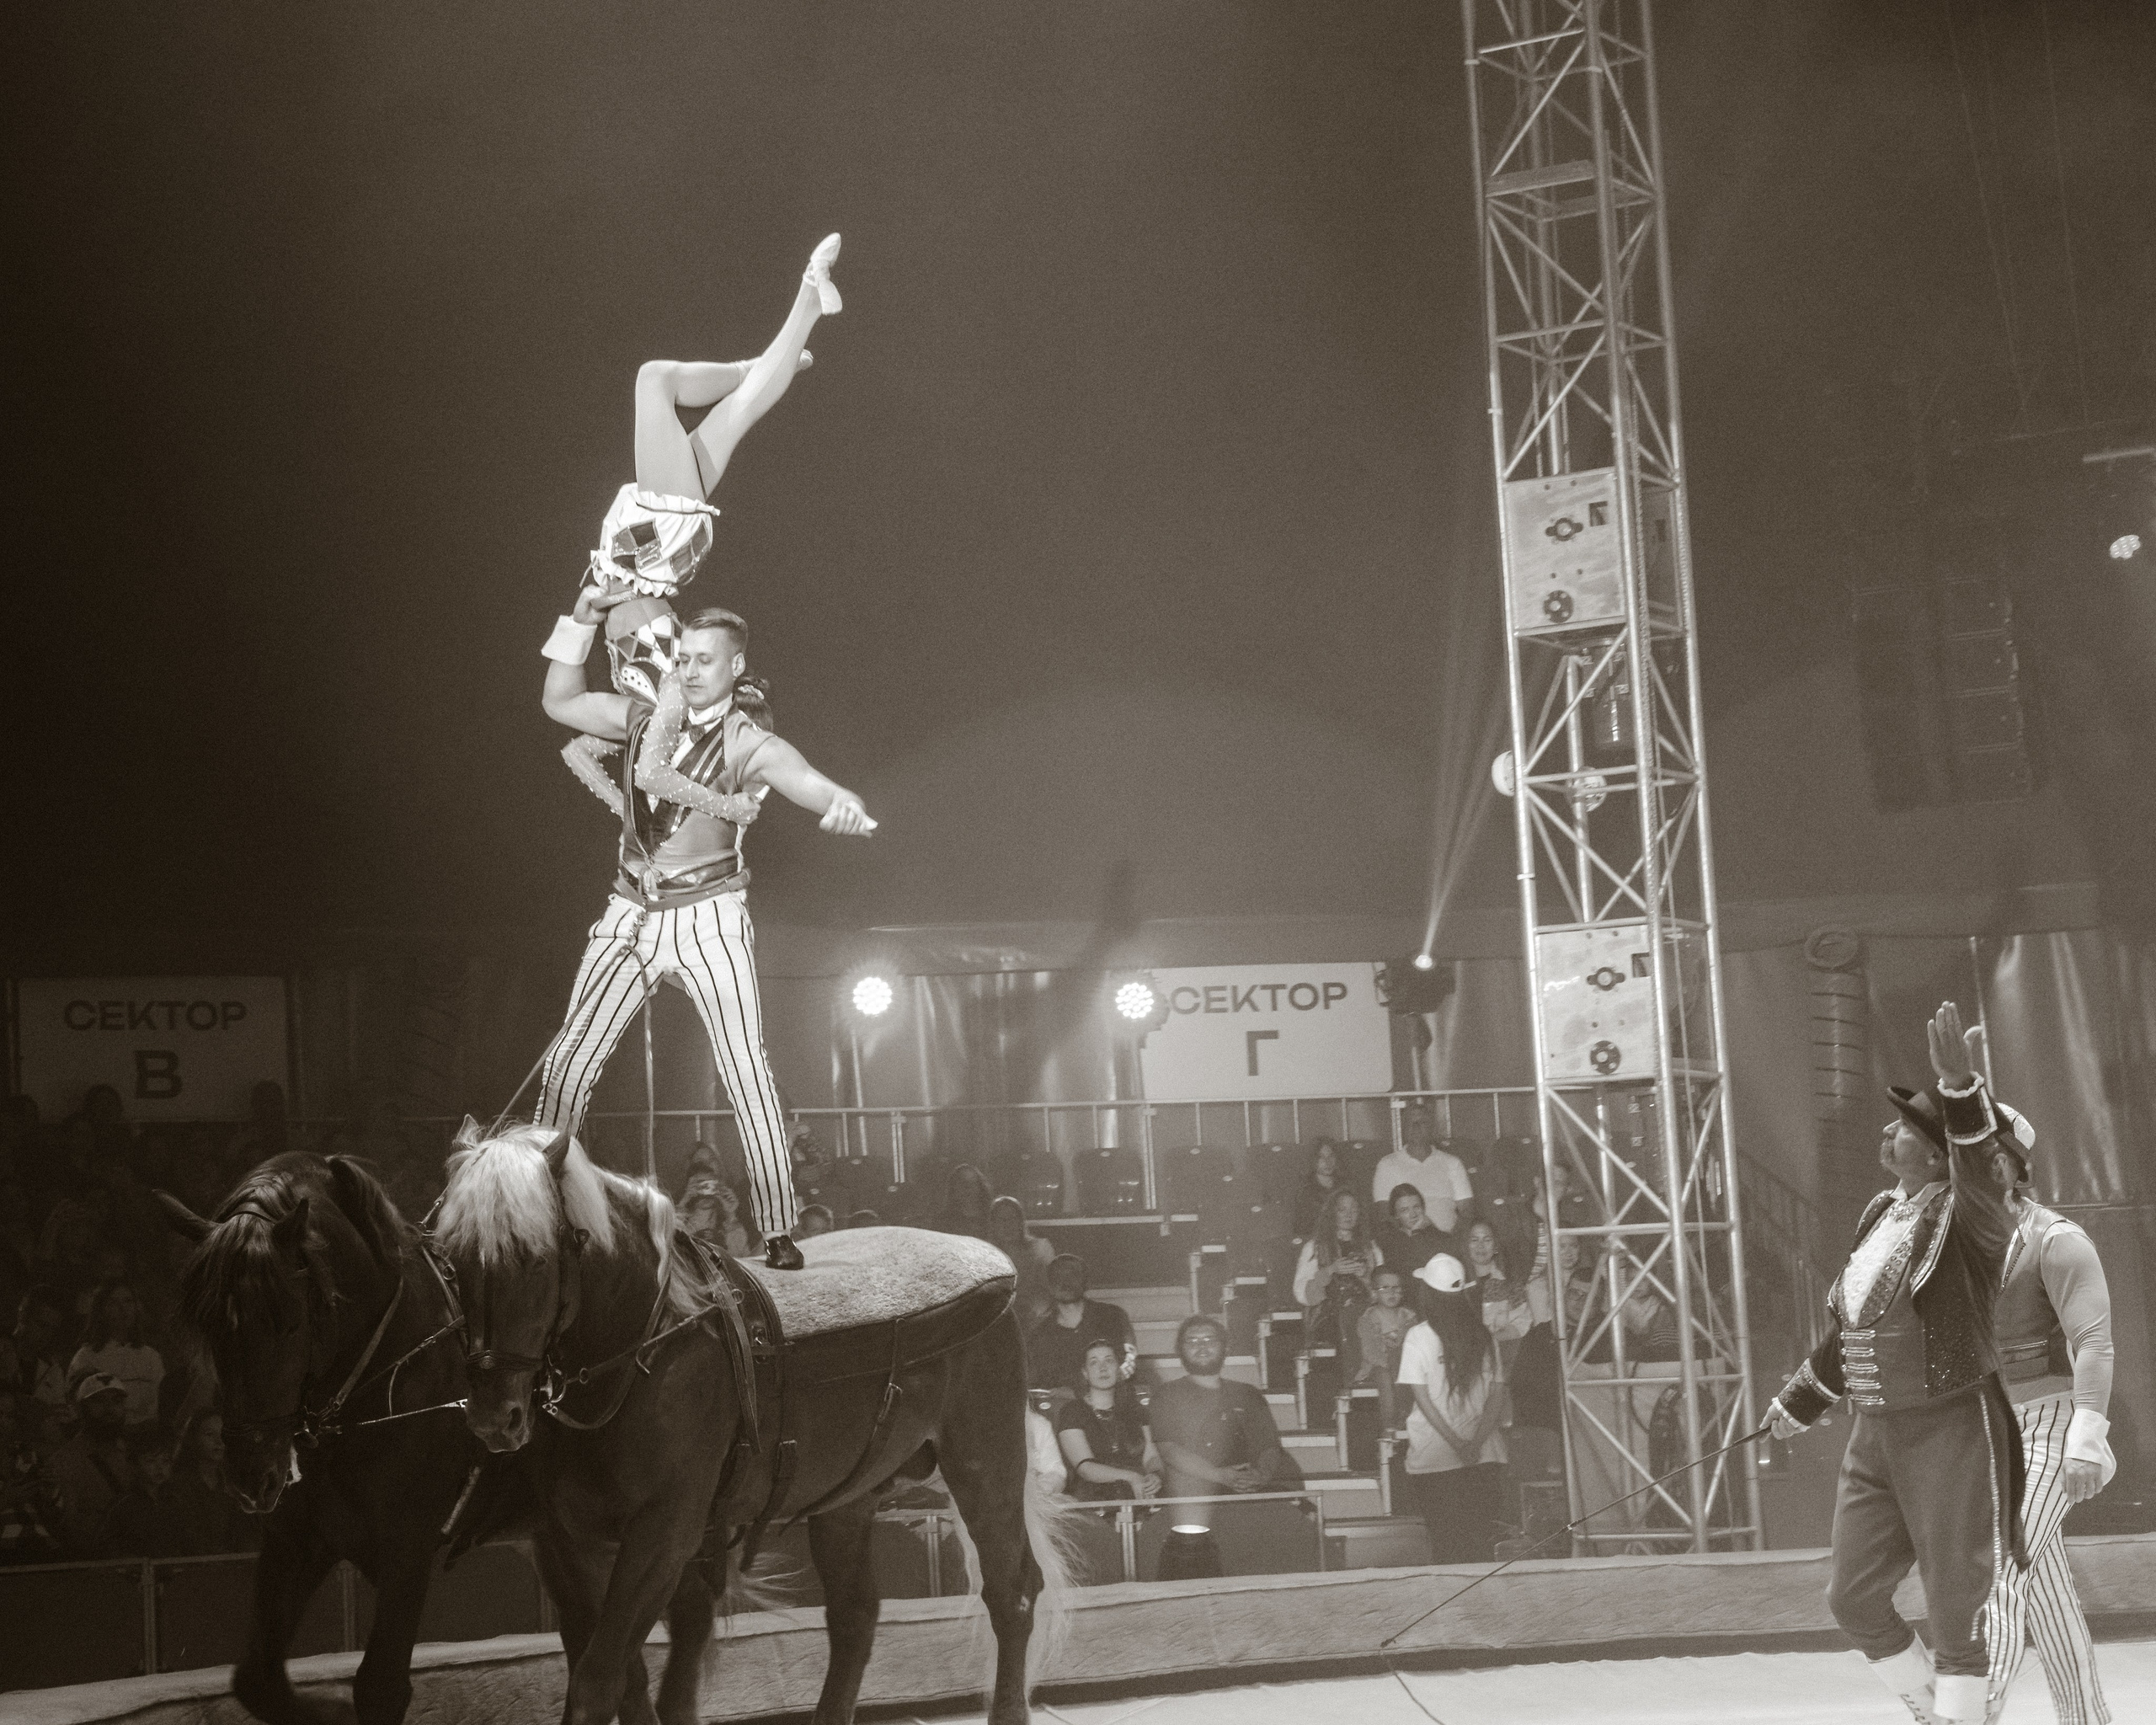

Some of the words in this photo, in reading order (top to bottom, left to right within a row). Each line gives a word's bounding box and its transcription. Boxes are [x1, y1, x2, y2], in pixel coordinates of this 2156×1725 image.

[64, 1001, 247, 1031] СЕКТОР
[1169, 982, 1348, 1014] СЕКТОР
[1246, 1030, 1278, 1076] Г
[135, 1050, 183, 1098] В
